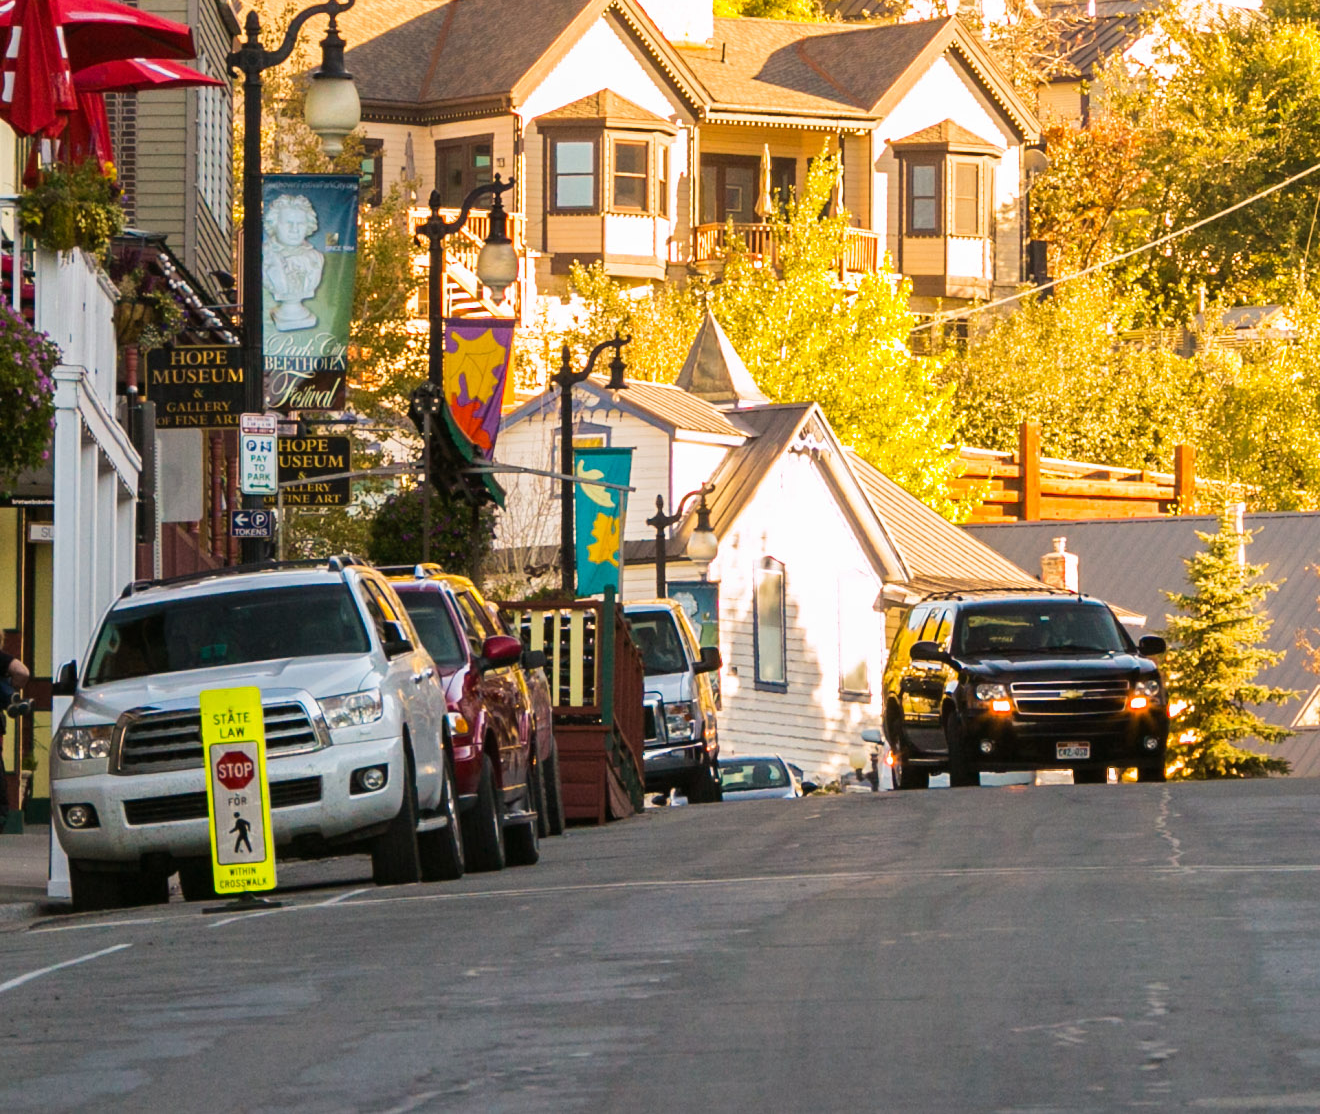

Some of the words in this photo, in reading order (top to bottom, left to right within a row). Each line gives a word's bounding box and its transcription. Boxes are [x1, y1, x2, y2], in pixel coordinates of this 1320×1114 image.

[170, 350, 228, 366] HOPE
[152, 368, 244, 385] MUSEUM
[192, 388, 204, 399] &
[166, 400, 232, 413] GALLERY
[156, 417, 171, 426] OF
[175, 415, 208, 426] FINE
[214, 414, 240, 426] ART
[278, 438, 329, 453] HOPE
[250, 454, 268, 463] PAY
[278, 454, 344, 468] USEUM
[254, 464, 266, 472] TO
[247, 472, 271, 481] PARK
[284, 482, 332, 493] ALLERY
[314, 493, 342, 504] ART
[235, 528, 268, 537] TOKENS
[213, 712, 251, 725] STATE
[220, 727, 245, 739] LAW
[218, 762, 253, 779] STOP
[228, 796, 248, 807] FOR
[229, 867, 257, 877] WITHIN
[219, 877, 268, 890] CROSSWALK
